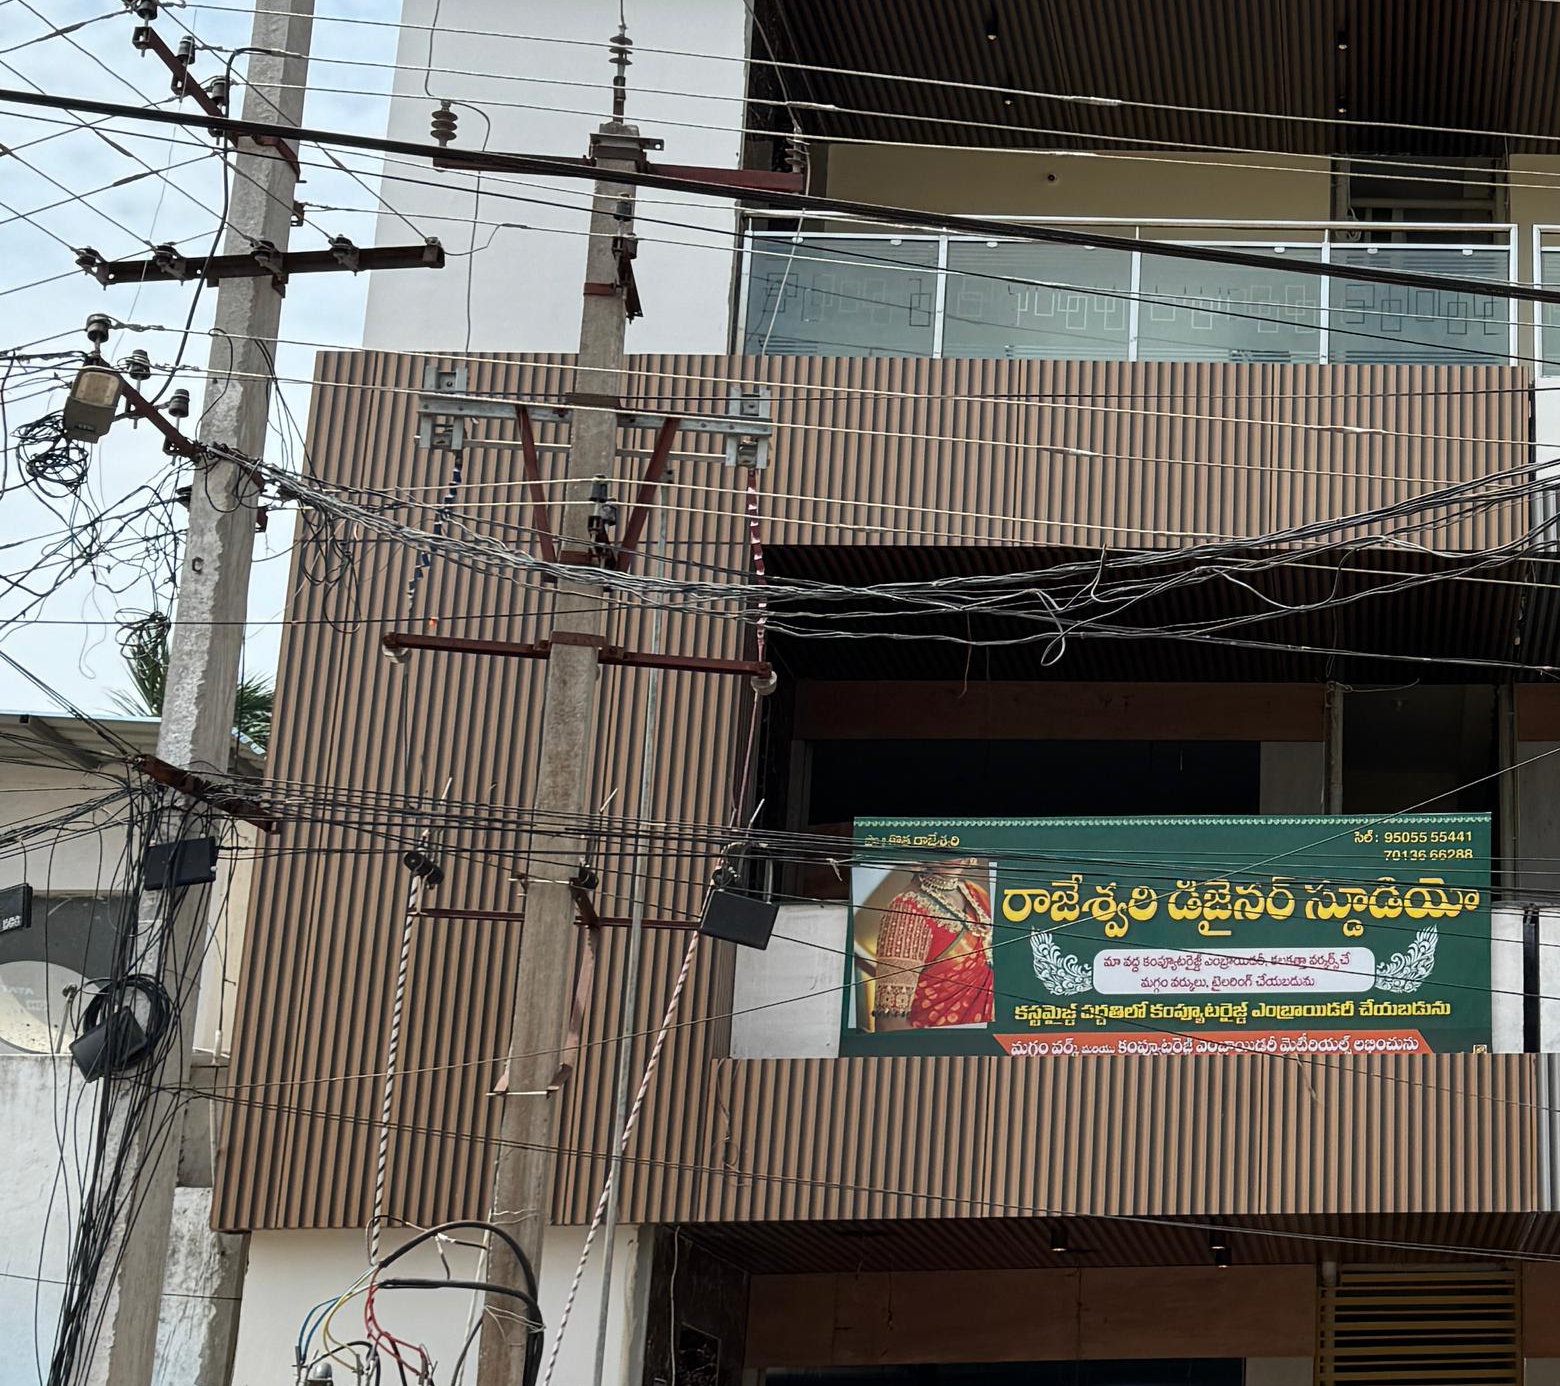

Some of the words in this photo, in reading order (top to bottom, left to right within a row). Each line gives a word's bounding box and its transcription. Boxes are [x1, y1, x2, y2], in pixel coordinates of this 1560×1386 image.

[1384, 831, 1428, 843] 95055
[1430, 830, 1472, 843] 55441
[1384, 849, 1427, 861] 70136
[1002, 874, 1158, 938] రాజేశ్వరి
[1103, 956, 1121, 967] మా
